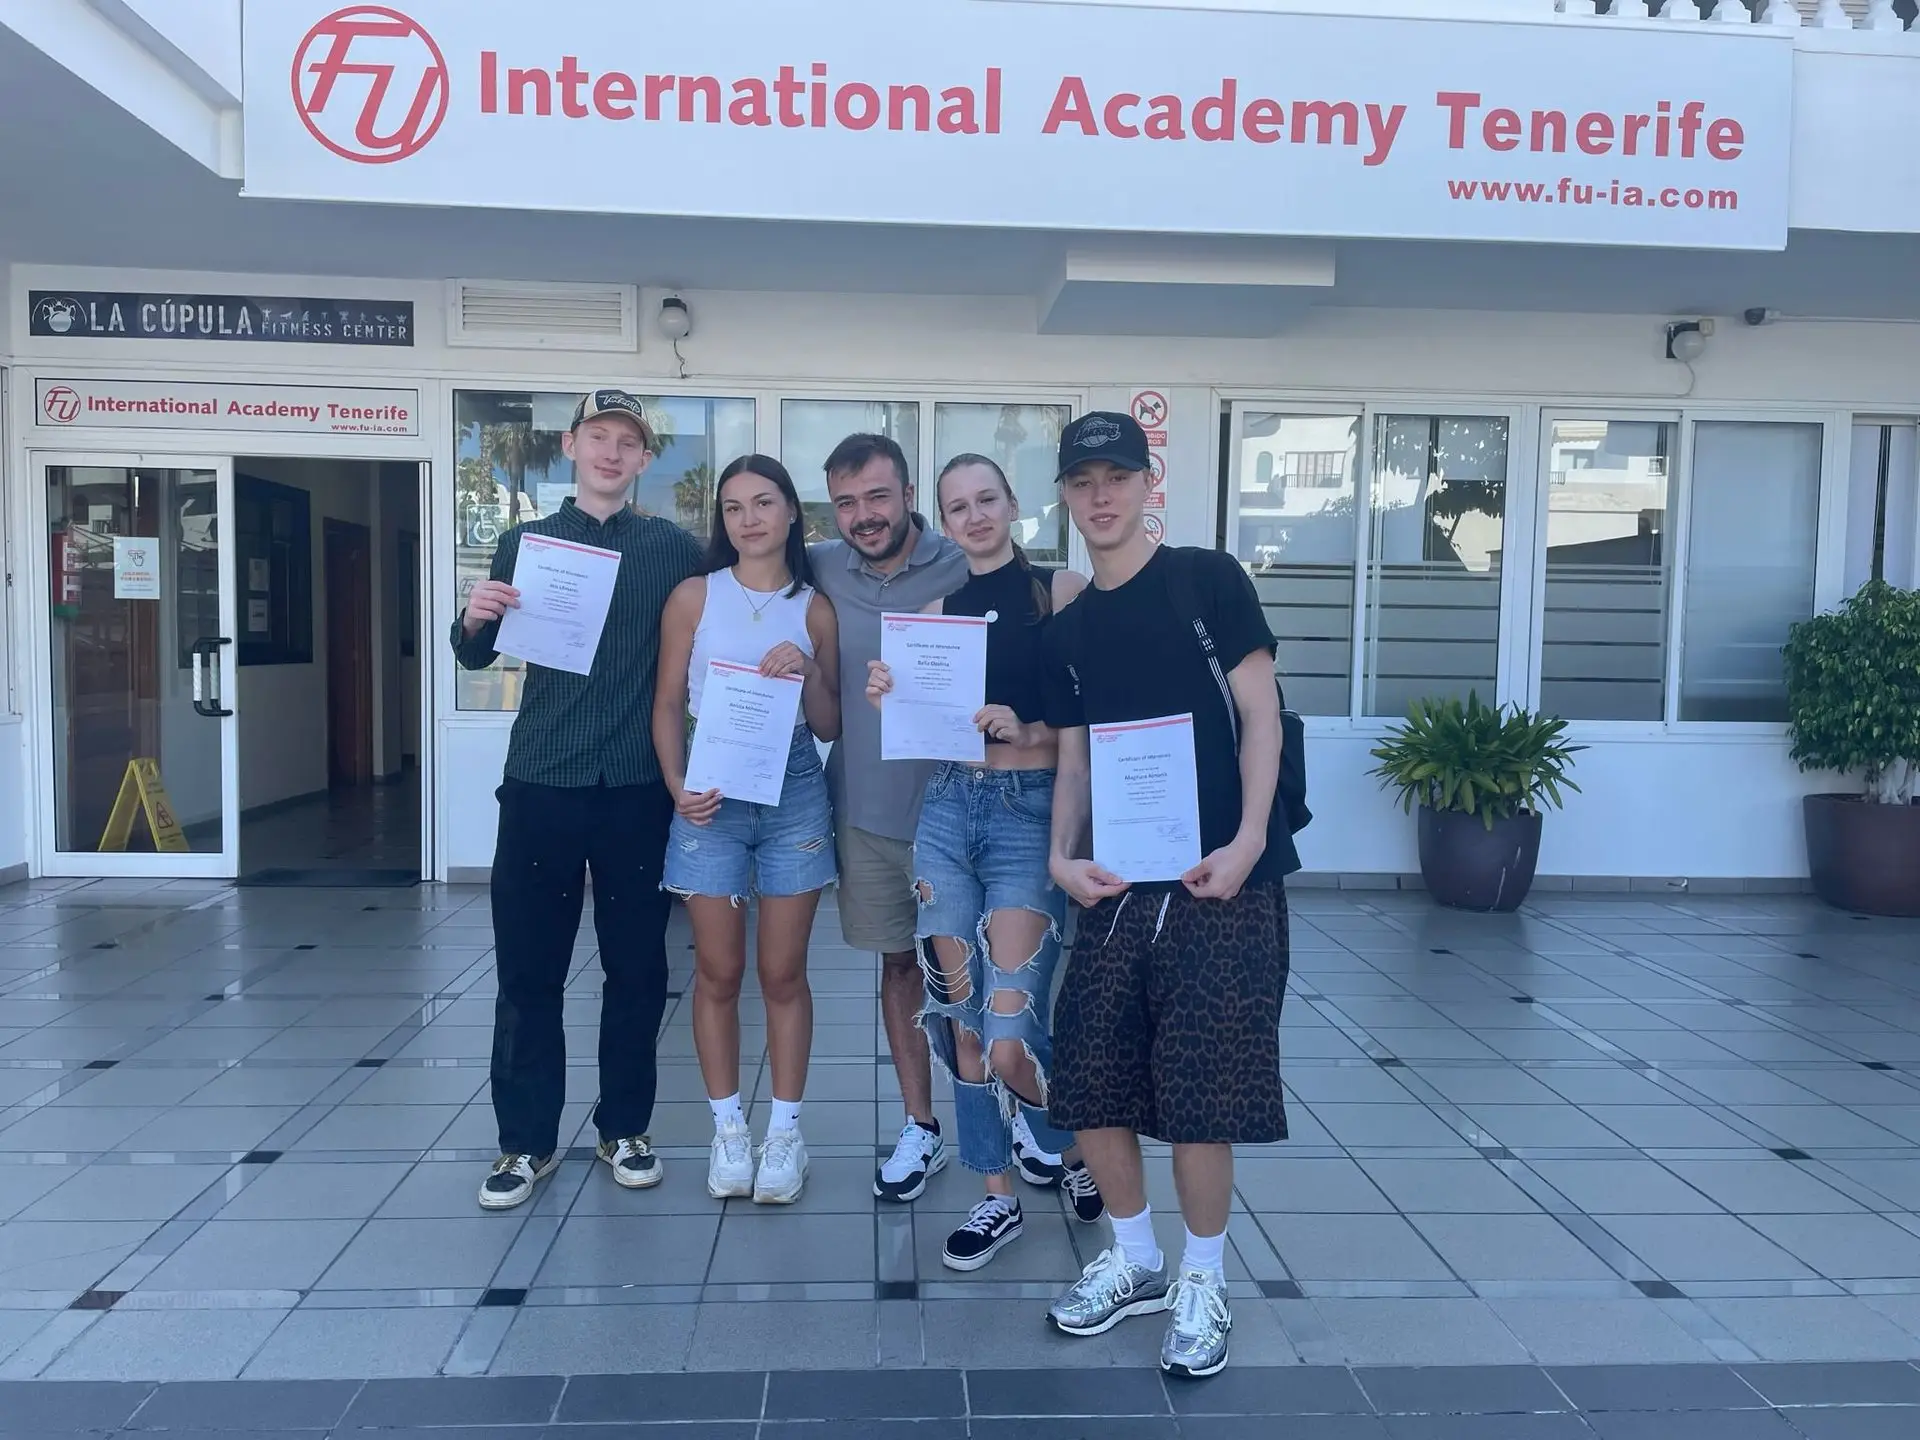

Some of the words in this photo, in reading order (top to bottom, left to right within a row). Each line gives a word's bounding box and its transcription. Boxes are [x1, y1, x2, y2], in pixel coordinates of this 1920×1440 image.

[482, 51, 1001, 134] International
[1042, 76, 1406, 165] Academy
[1436, 92, 1745, 160] Tenerife
[1447, 177, 1739, 210] www.fu-ia.com
[90, 301, 125, 332] LA
[142, 298, 253, 335] CÚPULA
[261, 321, 332, 337] FITNESS
[343, 324, 407, 340] CENTER
[87, 397, 218, 415] International
[227, 399, 320, 421] Academy
[327, 404, 408, 420] Tenerife
[331, 424, 408, 433] www.fu-ia.com
